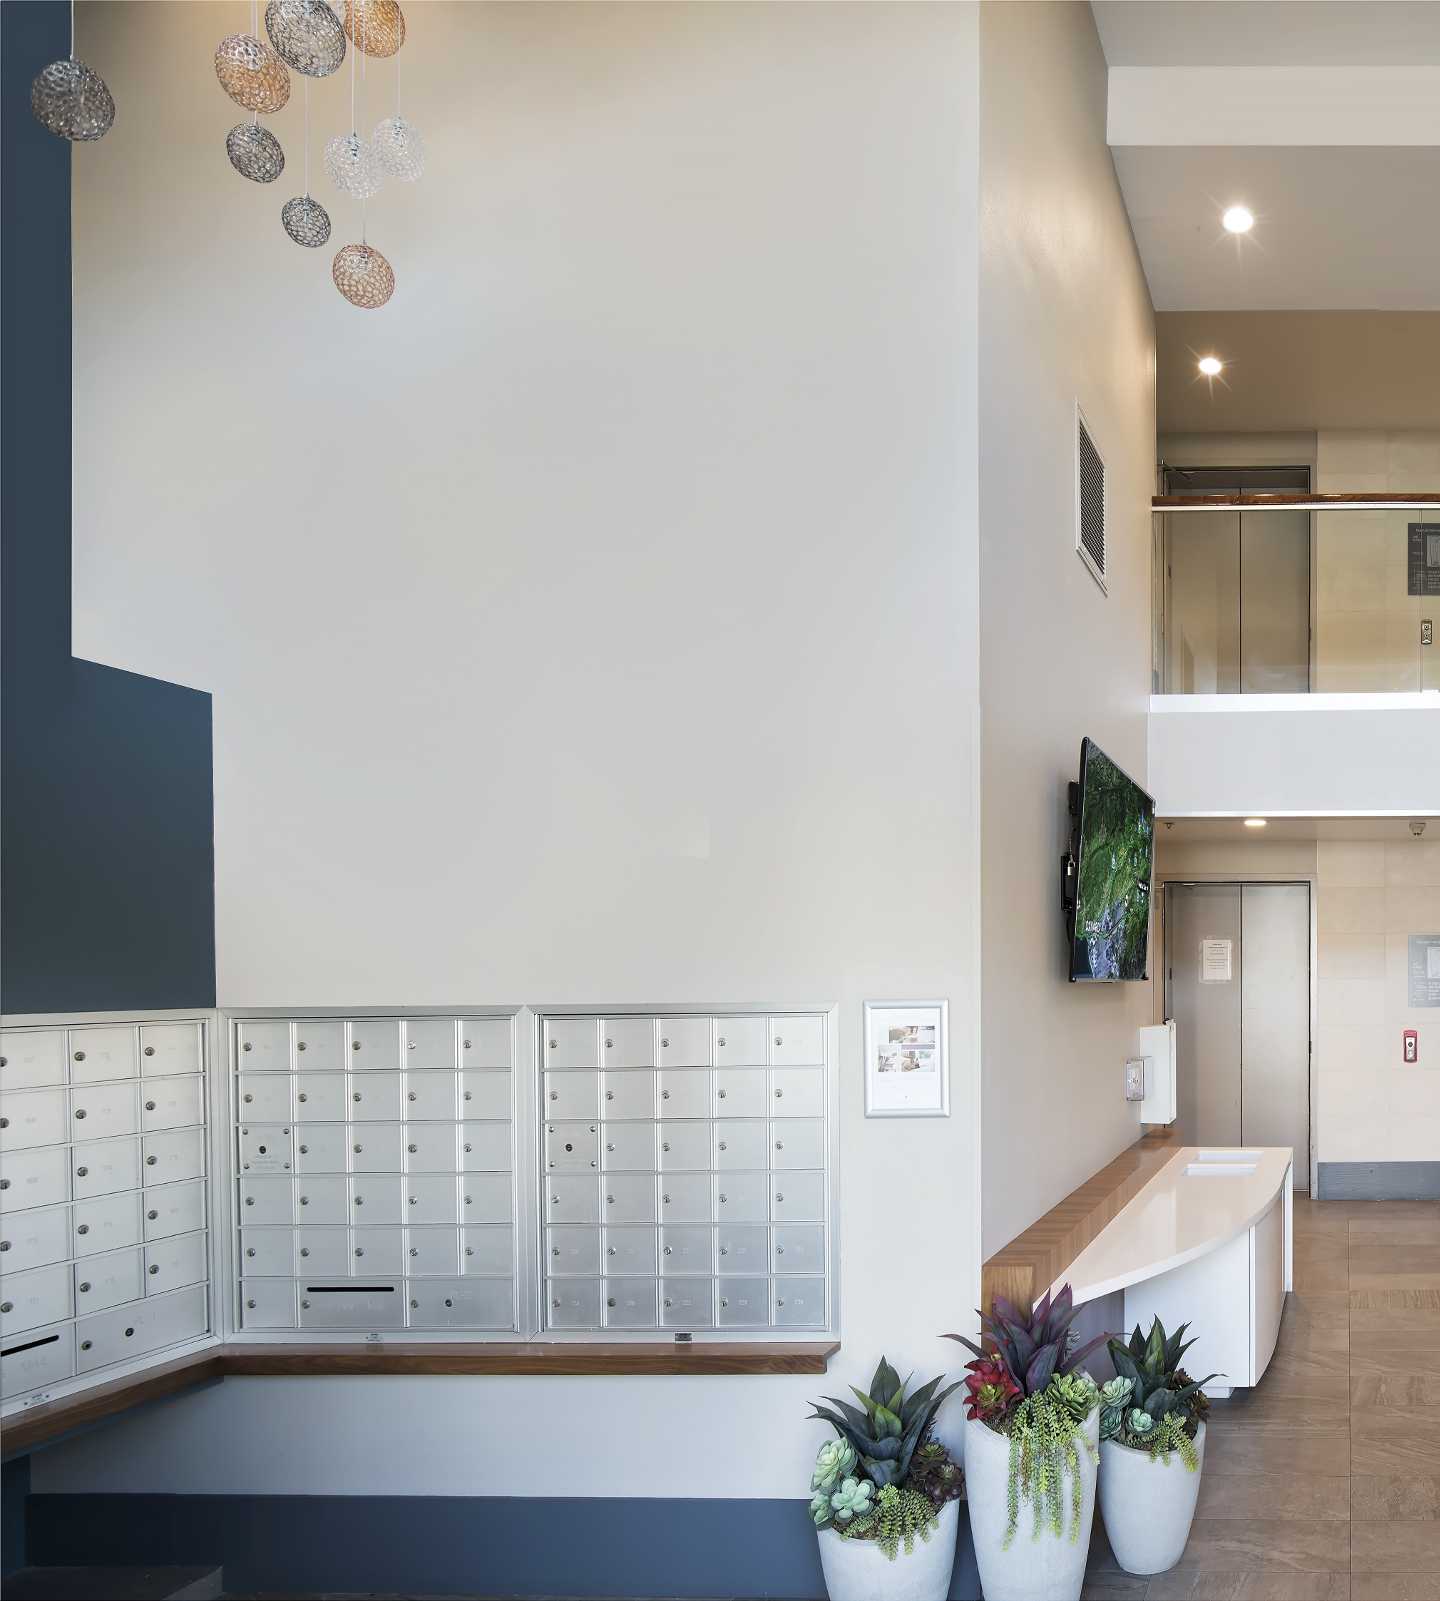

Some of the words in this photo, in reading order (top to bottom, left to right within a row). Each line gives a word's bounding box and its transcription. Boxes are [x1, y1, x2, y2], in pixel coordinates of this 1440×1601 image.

[24, 1056, 35, 1064] 167
[25, 1116, 37, 1124] 168
[26, 1176, 38, 1184] 169
[28, 1236, 39, 1244] 170
[449, 1290, 472, 1301] PL-2
[29, 1296, 40, 1304] 171
[366, 1300, 387, 1311] MAIL
[133, 1311, 157, 1326] PL-1
[19, 1355, 50, 1372] MAIL
